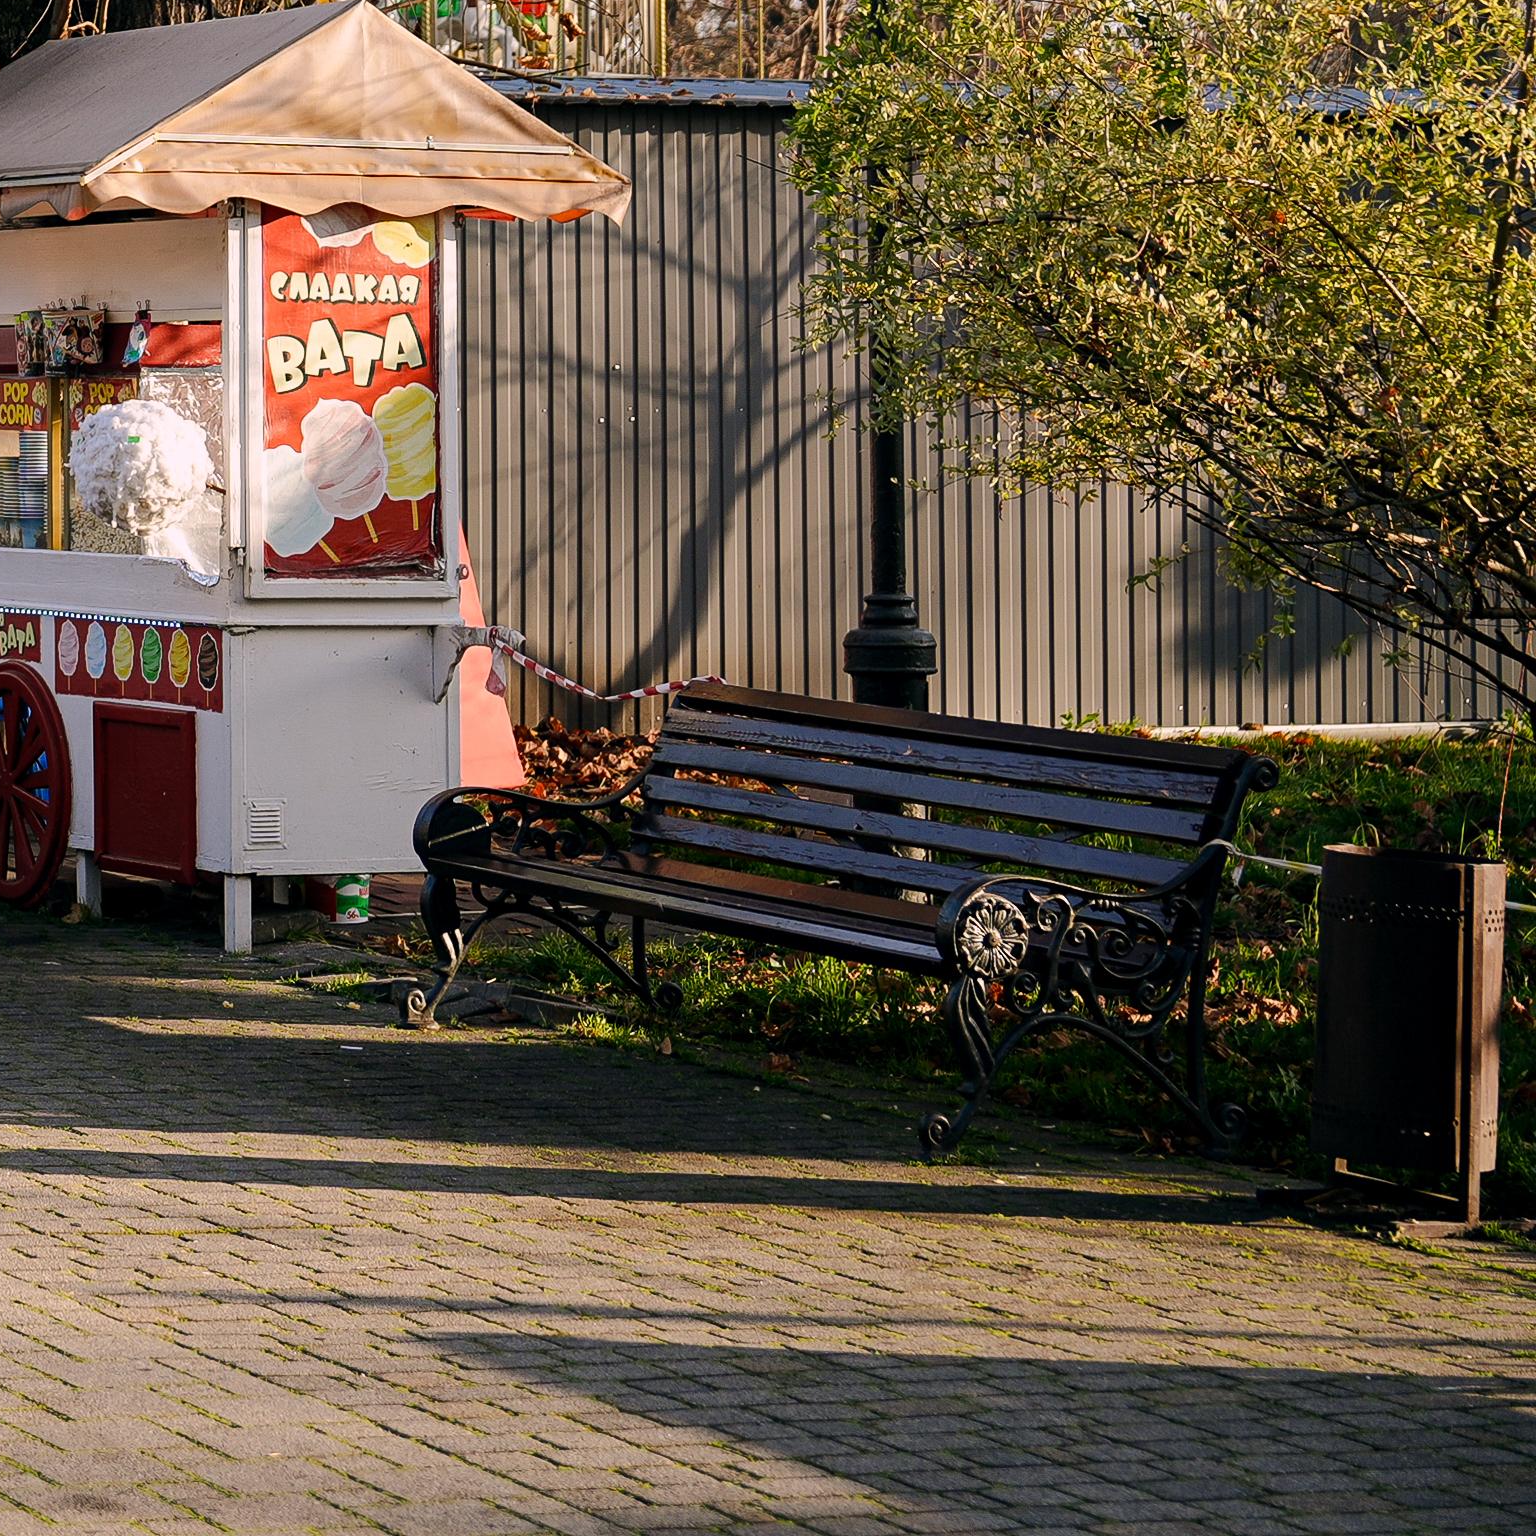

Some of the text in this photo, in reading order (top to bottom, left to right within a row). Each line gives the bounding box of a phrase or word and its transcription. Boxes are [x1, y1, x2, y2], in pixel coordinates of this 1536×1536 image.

[269, 271, 421, 305] СЛАДКАЯ
[267, 312, 426, 394] ВАТА
[3, 382, 29, 403] POP
[88, 382, 115, 404] POP
